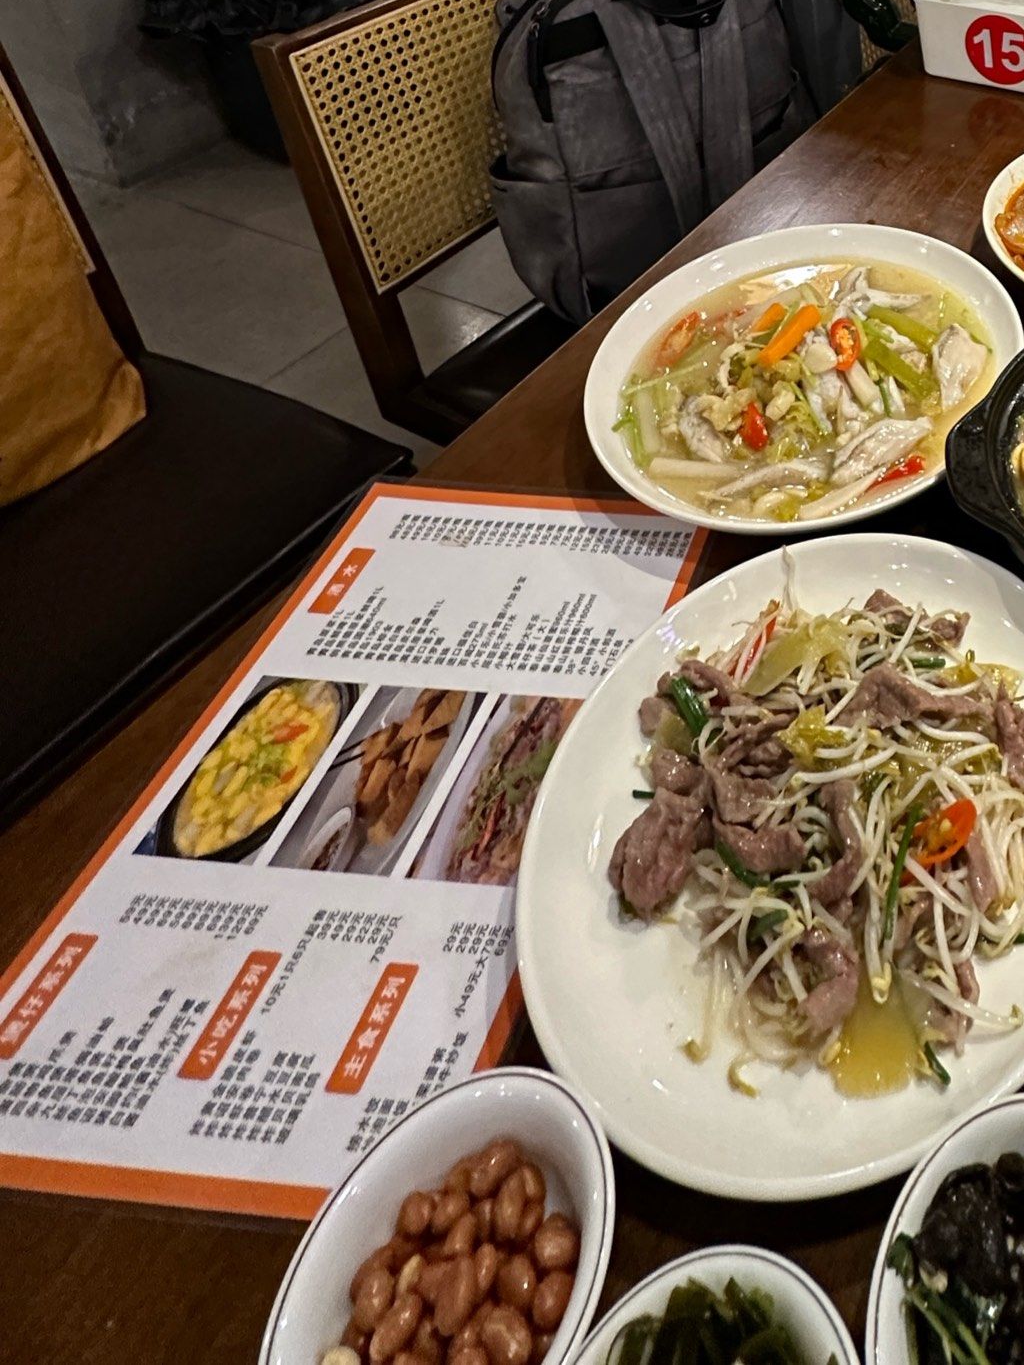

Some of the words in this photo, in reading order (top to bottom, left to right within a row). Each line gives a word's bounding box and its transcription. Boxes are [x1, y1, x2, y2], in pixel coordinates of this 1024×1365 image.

[192, 962, 270, 1065] 小吃系列
[340, 975, 407, 1078] 主食系列
